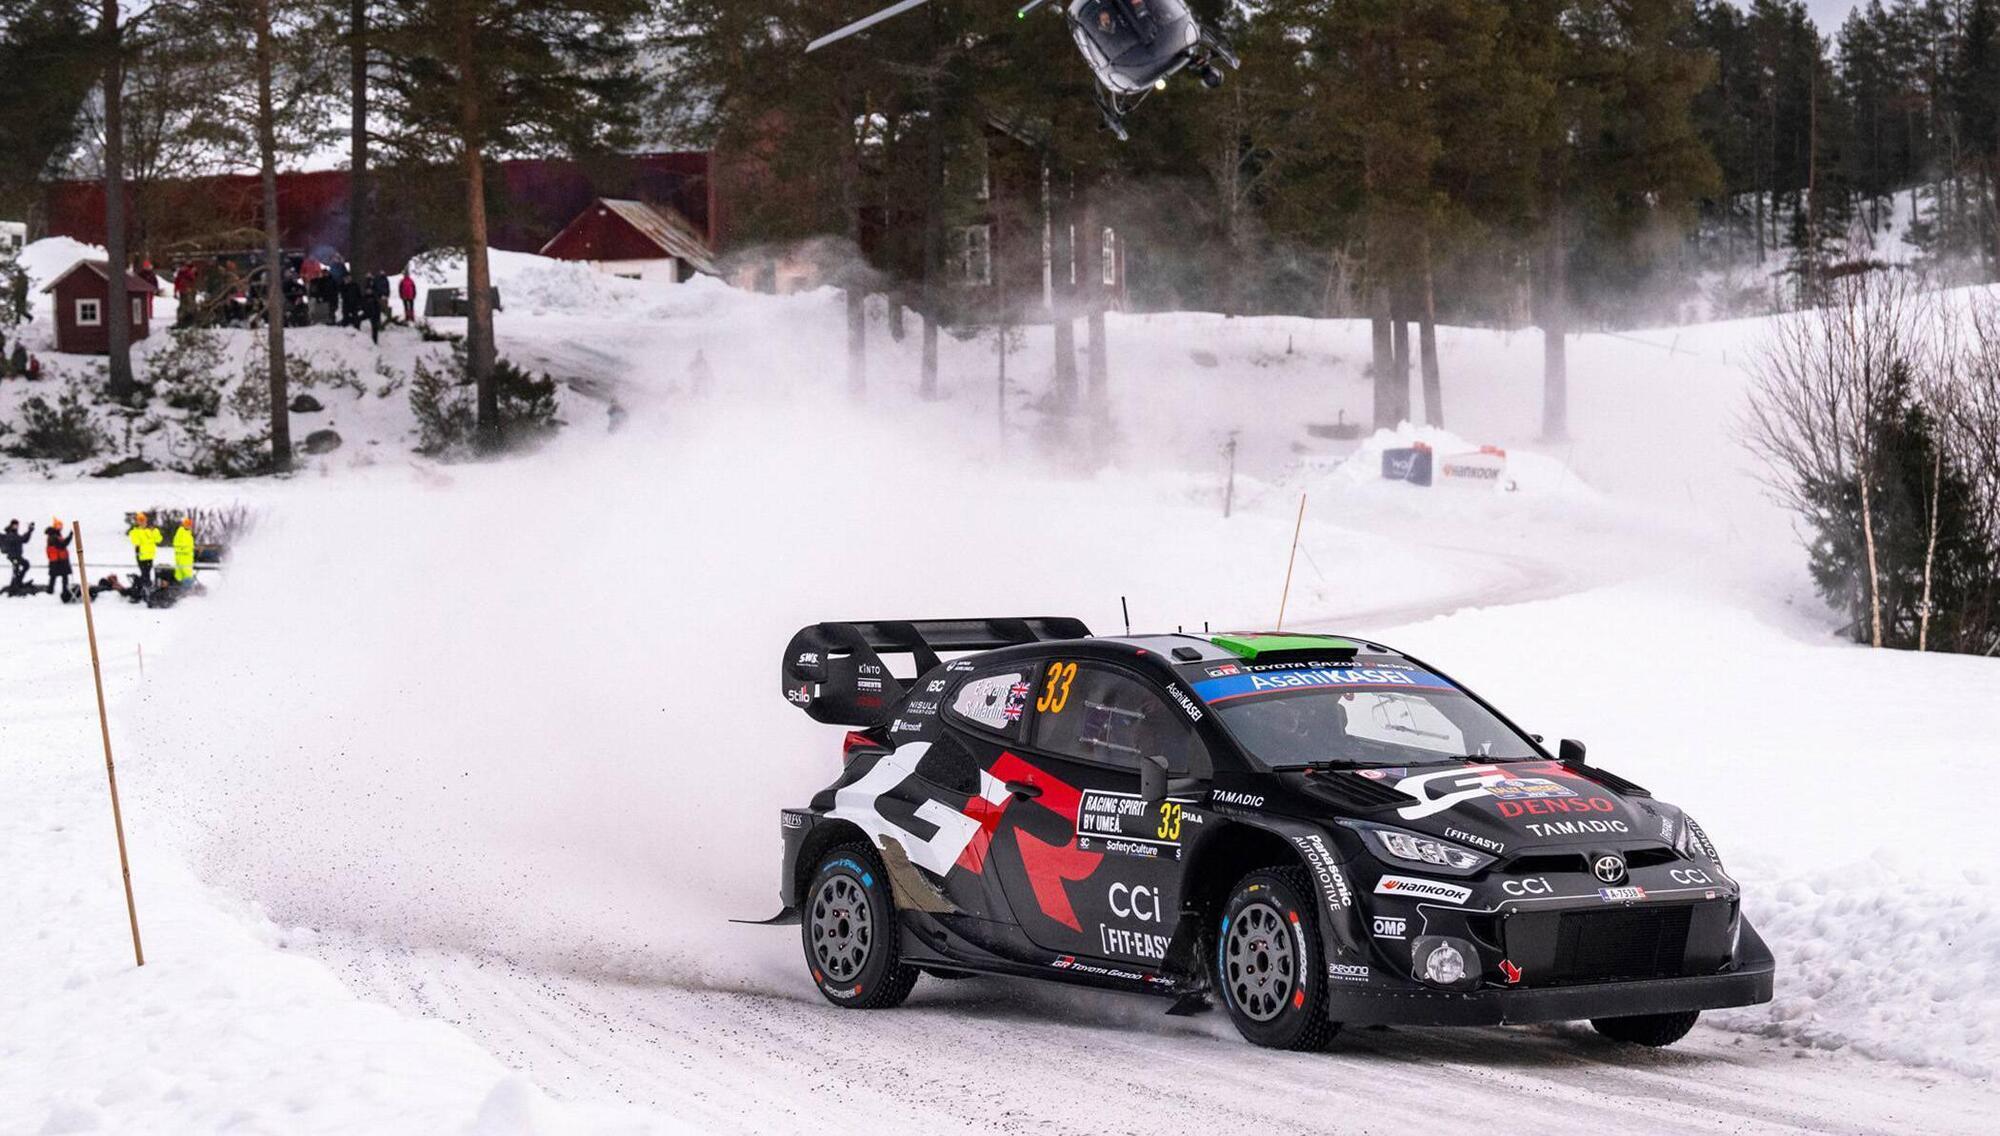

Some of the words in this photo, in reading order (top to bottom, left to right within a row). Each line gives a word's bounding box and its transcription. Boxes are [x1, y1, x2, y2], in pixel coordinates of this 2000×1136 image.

[1241, 662, 1305, 672] TOYOTA
[1037, 661, 1077, 713] 33
[1250, 669, 1416, 690] AsahiKASEI
[788, 683, 810, 703] Stilo
[1166, 682, 1203, 722] AsahiKASEI
[908, 701, 938, 711] NISULA
[899, 721, 922, 732] Microsoft
[1085, 796, 1117, 814] RACING
[1117, 798, 1148, 817] SPIRIT
[1212, 789, 1264, 807] TAMADIC
[1496, 796, 1614, 818] DENSO
[1083, 814, 1096, 830] BY
[1157, 802, 1181, 840] 33
[1181, 810, 1204, 824] PIAA
[1526, 819, 1628, 839] TAMADIC
[1106, 839, 1158, 855] SafetyCulture
[1292, 836, 1341, 911] AUTOMOTIVE
[1306, 834, 1352, 908] Panasonic
[1373, 919, 1406, 936] OMP
[1071, 962, 1106, 975] TOYOTA
[1107, 968, 1143, 980] GAZOO
